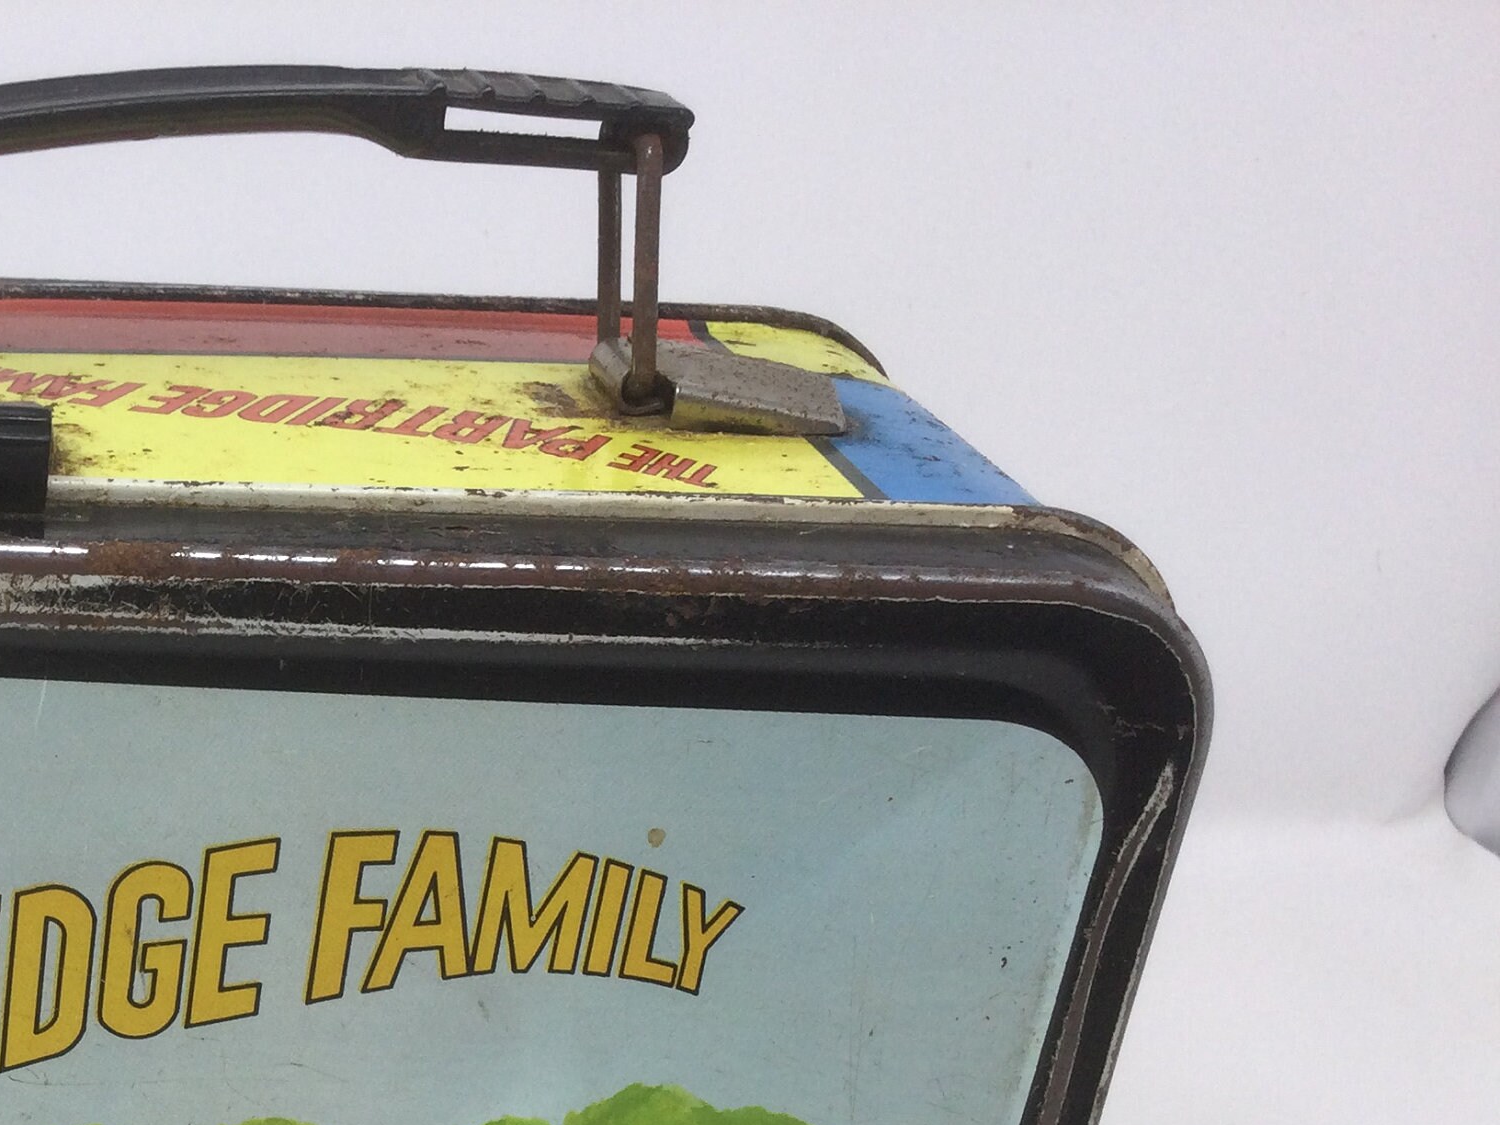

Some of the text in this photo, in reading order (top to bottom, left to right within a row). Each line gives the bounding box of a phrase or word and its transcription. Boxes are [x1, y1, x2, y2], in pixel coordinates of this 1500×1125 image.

[128, 384, 612, 461] PARTRIDGE
[608, 443, 718, 488] THE
[304, 829, 746, 1006] FAMILY
